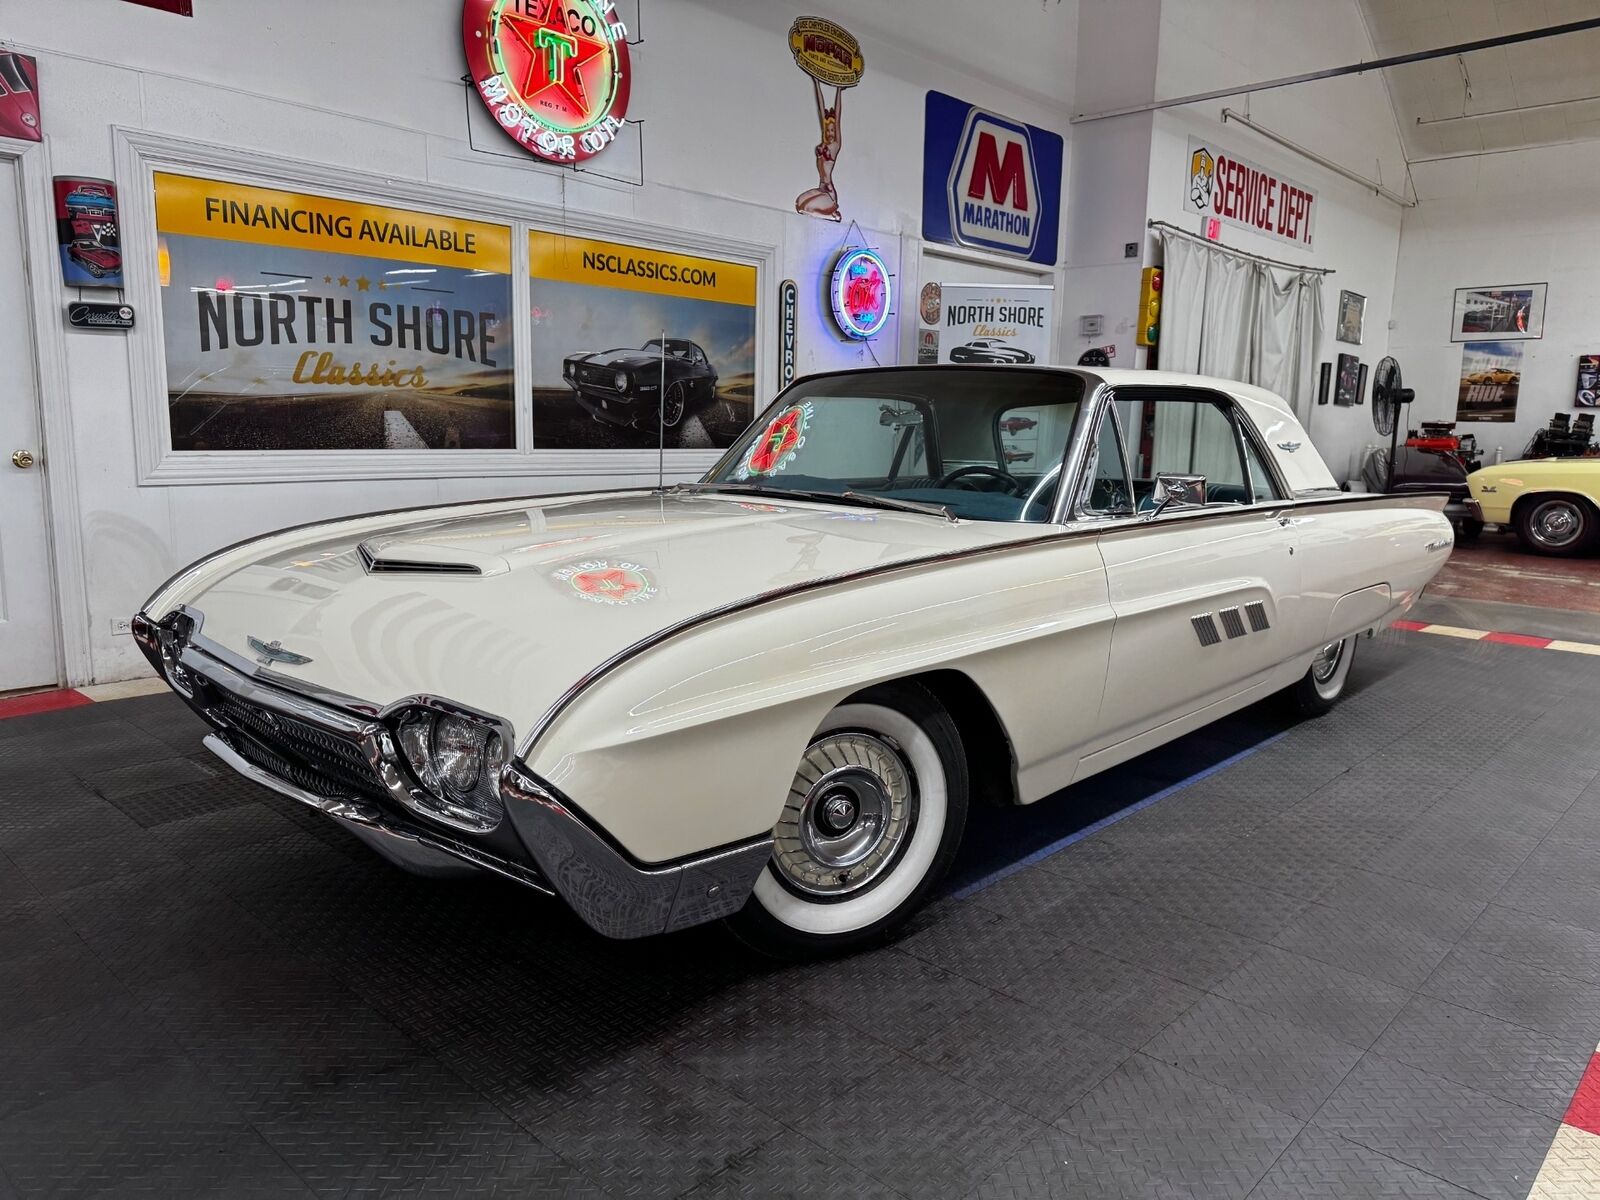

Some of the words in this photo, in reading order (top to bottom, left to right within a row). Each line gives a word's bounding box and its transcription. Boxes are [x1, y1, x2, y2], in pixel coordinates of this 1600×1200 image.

[513, 0, 597, 36] TEXACO
[803, 34, 853, 70] MOPAR
[479, 75, 575, 159] MOTOR
[580, 115, 625, 153] OIL
[968, 131, 1028, 211] M
[1214, 155, 1276, 231] SERVICE
[1277, 182, 1313, 245] DEPT.
[205, 197, 353, 239] FINANCING
[358, 219, 477, 255] AVAILABLE
[962, 202, 1030, 237] MARATHON
[582, 251, 717, 288] NSCLASSICS.COM
[197, 290, 353, 352] NORTH
[369, 302, 497, 367] SHORE
[947, 305, 995, 327] NORTH
[998, 306, 1045, 328] SHORE
[972, 324, 1017, 337] Classics
[291, 351, 430, 388] Classics
[1465, 384, 1505, 402] RIDE
